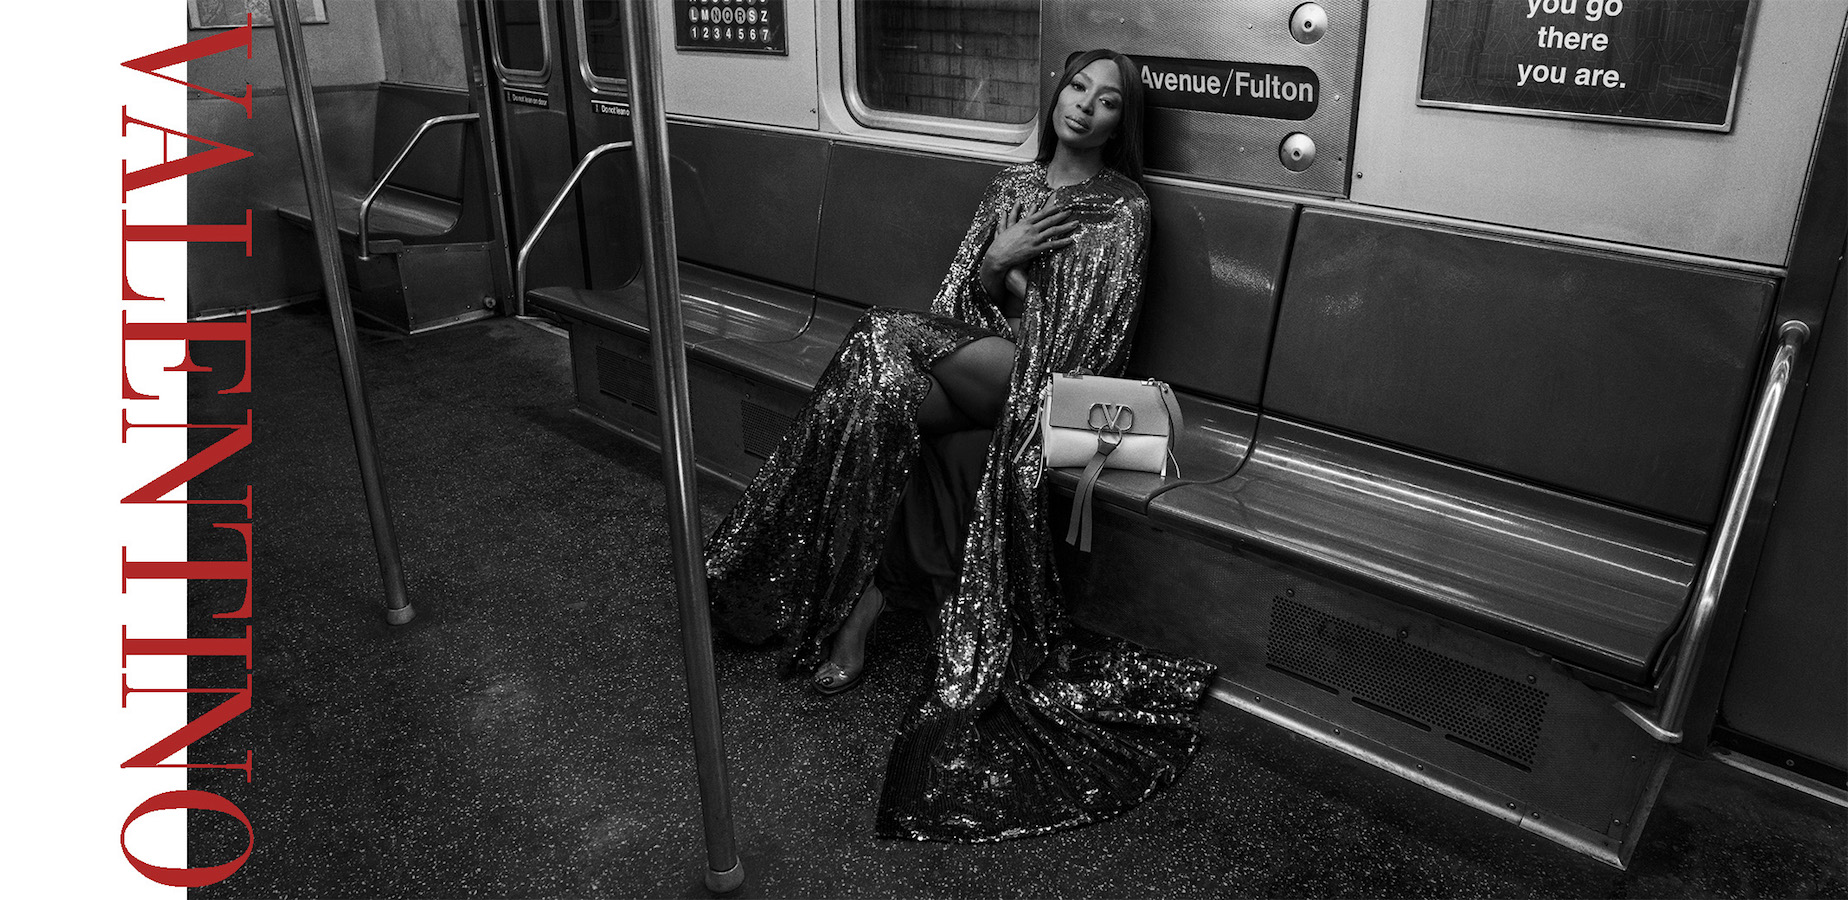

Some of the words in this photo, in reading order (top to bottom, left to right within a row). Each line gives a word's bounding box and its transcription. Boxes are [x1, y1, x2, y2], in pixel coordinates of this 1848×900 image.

[691, 9, 698, 20] L
[701, 9, 709, 21] M
[713, 9, 720, 21] N
[724, 9, 732, 22] Q
[737, 9, 744, 22] R
[749, 9, 756, 22] S
[760, 10, 768, 22] Z
[1527, 0, 1576, 18] you
[1585, 0, 1623, 22] go
[691, 27, 697, 38] 1
[703, 27, 709, 38] 2
[714, 27, 720, 39] 3
[725, 28, 732, 39] 4
[738, 28, 744, 40] 5
[750, 28, 756, 40] 6
[762, 29, 769, 41] 7
[1537, 25, 1609, 51] there
[1140, 65, 1314, 103] Avenue/Fulton
[1517, 63, 1566, 87] you
[1574, 68, 1626, 89] are.
